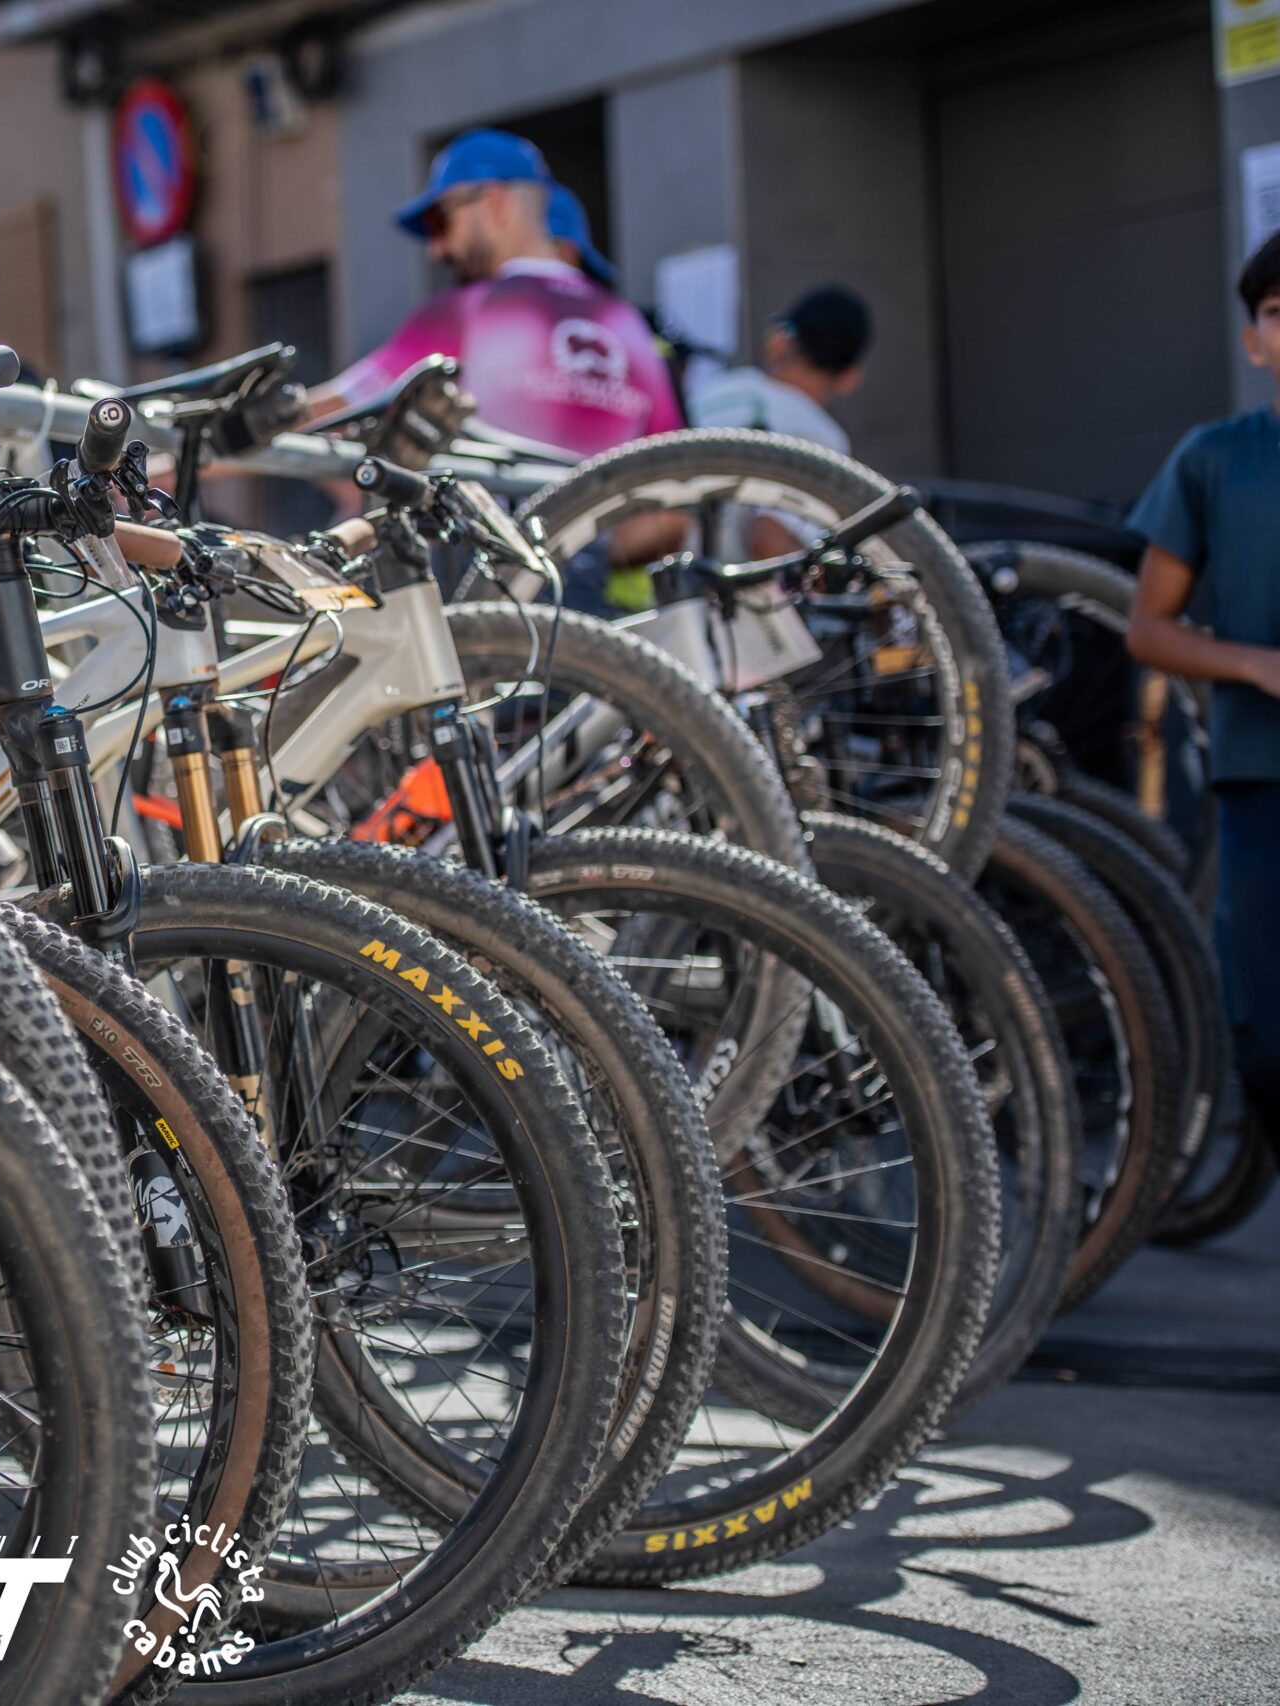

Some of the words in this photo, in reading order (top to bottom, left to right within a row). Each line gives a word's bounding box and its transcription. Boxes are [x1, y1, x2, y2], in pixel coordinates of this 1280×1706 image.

[358, 939, 524, 1081] MAXXIS
[90, 1016, 118, 1045] EXO
[122, 1046, 162, 1088] TR
[158, 1122, 176, 1147] MAVIC
[645, 1477, 813, 1554] MAXXIS
